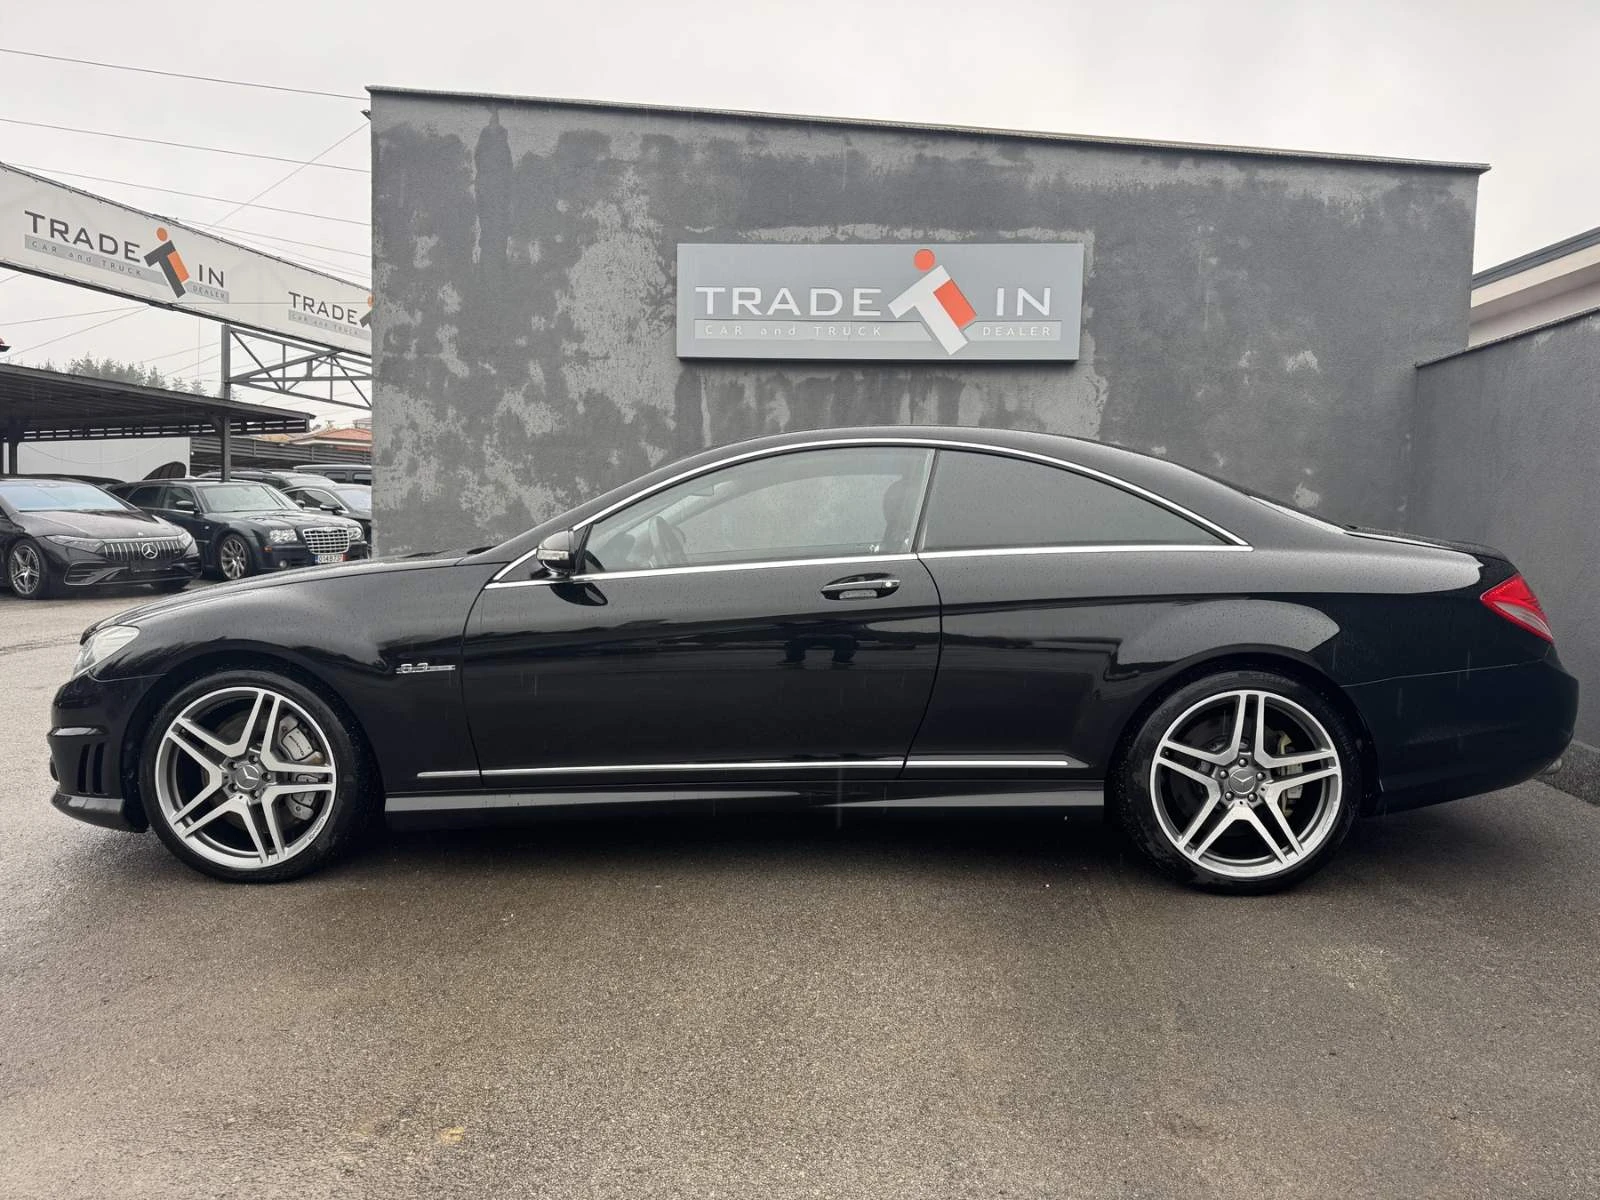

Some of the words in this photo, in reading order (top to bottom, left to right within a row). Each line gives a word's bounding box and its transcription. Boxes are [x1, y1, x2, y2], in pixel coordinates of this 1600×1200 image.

[24, 210, 141, 263] TRADE
[198, 264, 224, 288] IN
[31, 240, 57, 253] CAR
[101, 259, 142, 276] TRUCK
[192, 284, 226, 299] DEALER
[695, 286, 882, 317] TRADE
[996, 287, 1051, 317] IN
[288, 291, 358, 325] TRADE
[704, 325, 743, 337] CAR
[760, 326, 800, 337] and
[813, 326, 882, 337] TRUCK
[982, 326, 1051, 337] DEALER
